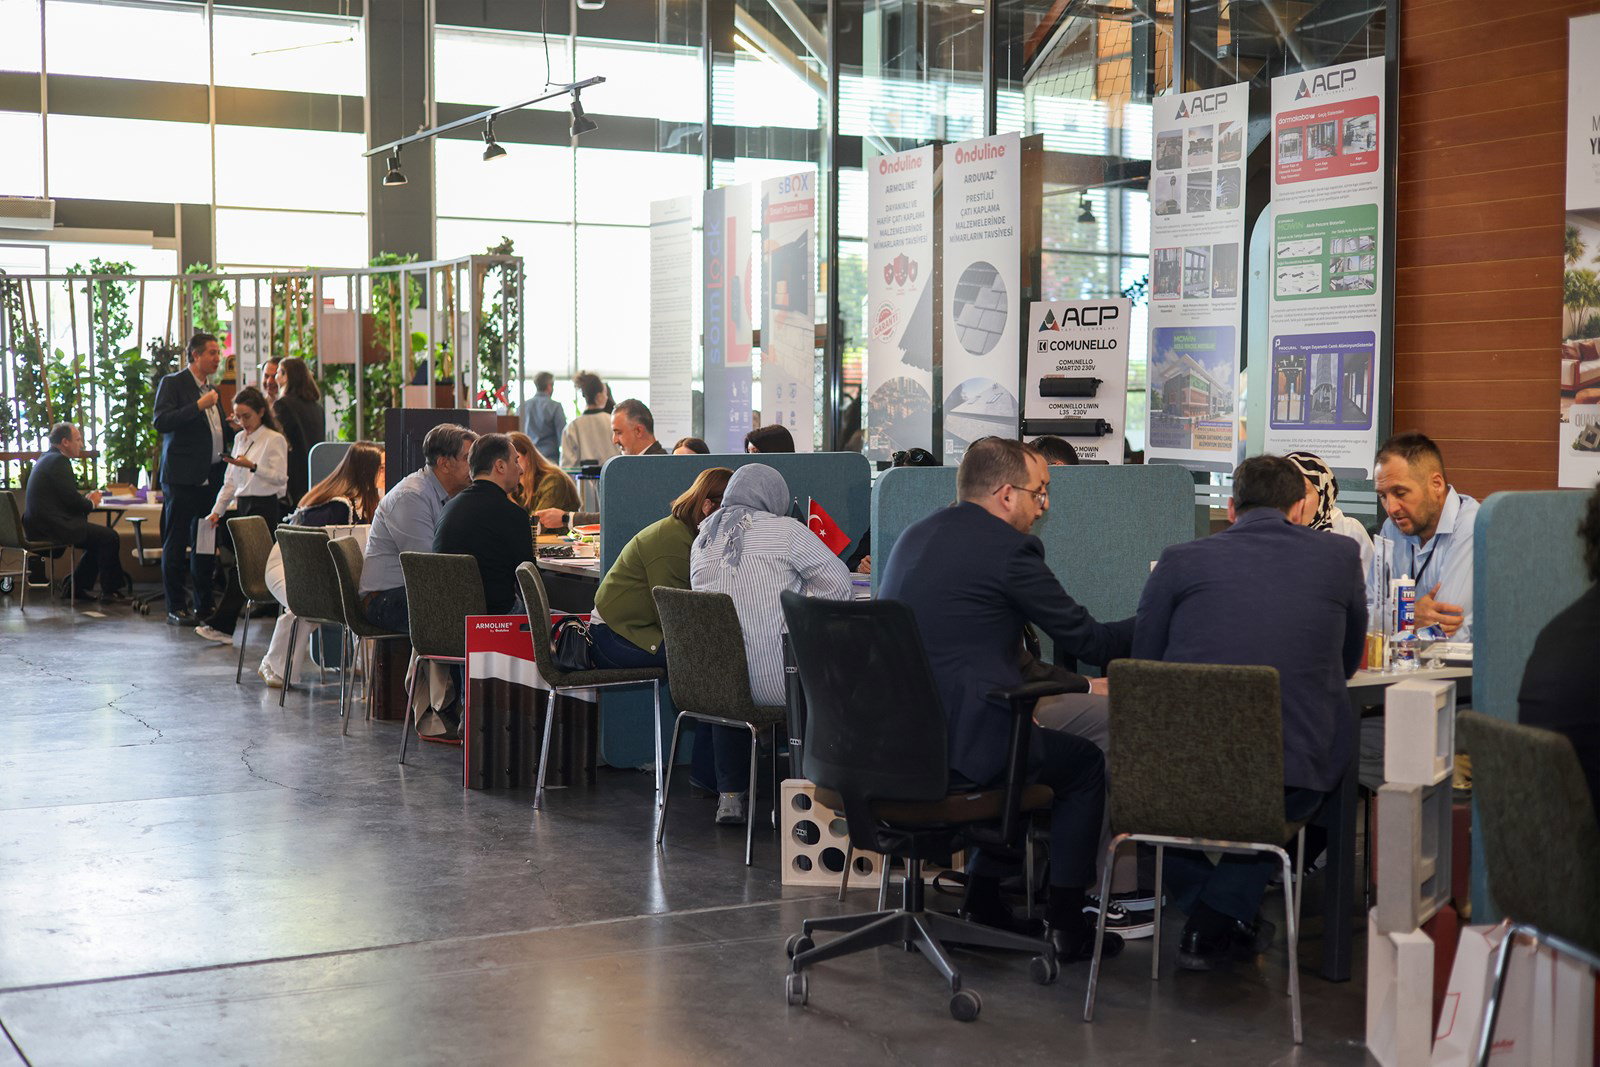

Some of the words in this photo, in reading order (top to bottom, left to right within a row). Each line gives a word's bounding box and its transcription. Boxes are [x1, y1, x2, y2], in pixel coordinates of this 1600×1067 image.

[1312, 68, 1356, 93] ACP
[1190, 92, 1227, 114] ACP
[955, 143, 1005, 164] Onduline
[880, 154, 922, 176] Onduline
[973, 204, 1000, 214] KAPLAMA
[1061, 306, 1119, 327] ACP
[1049, 339, 1118, 351] COMUNELLO
